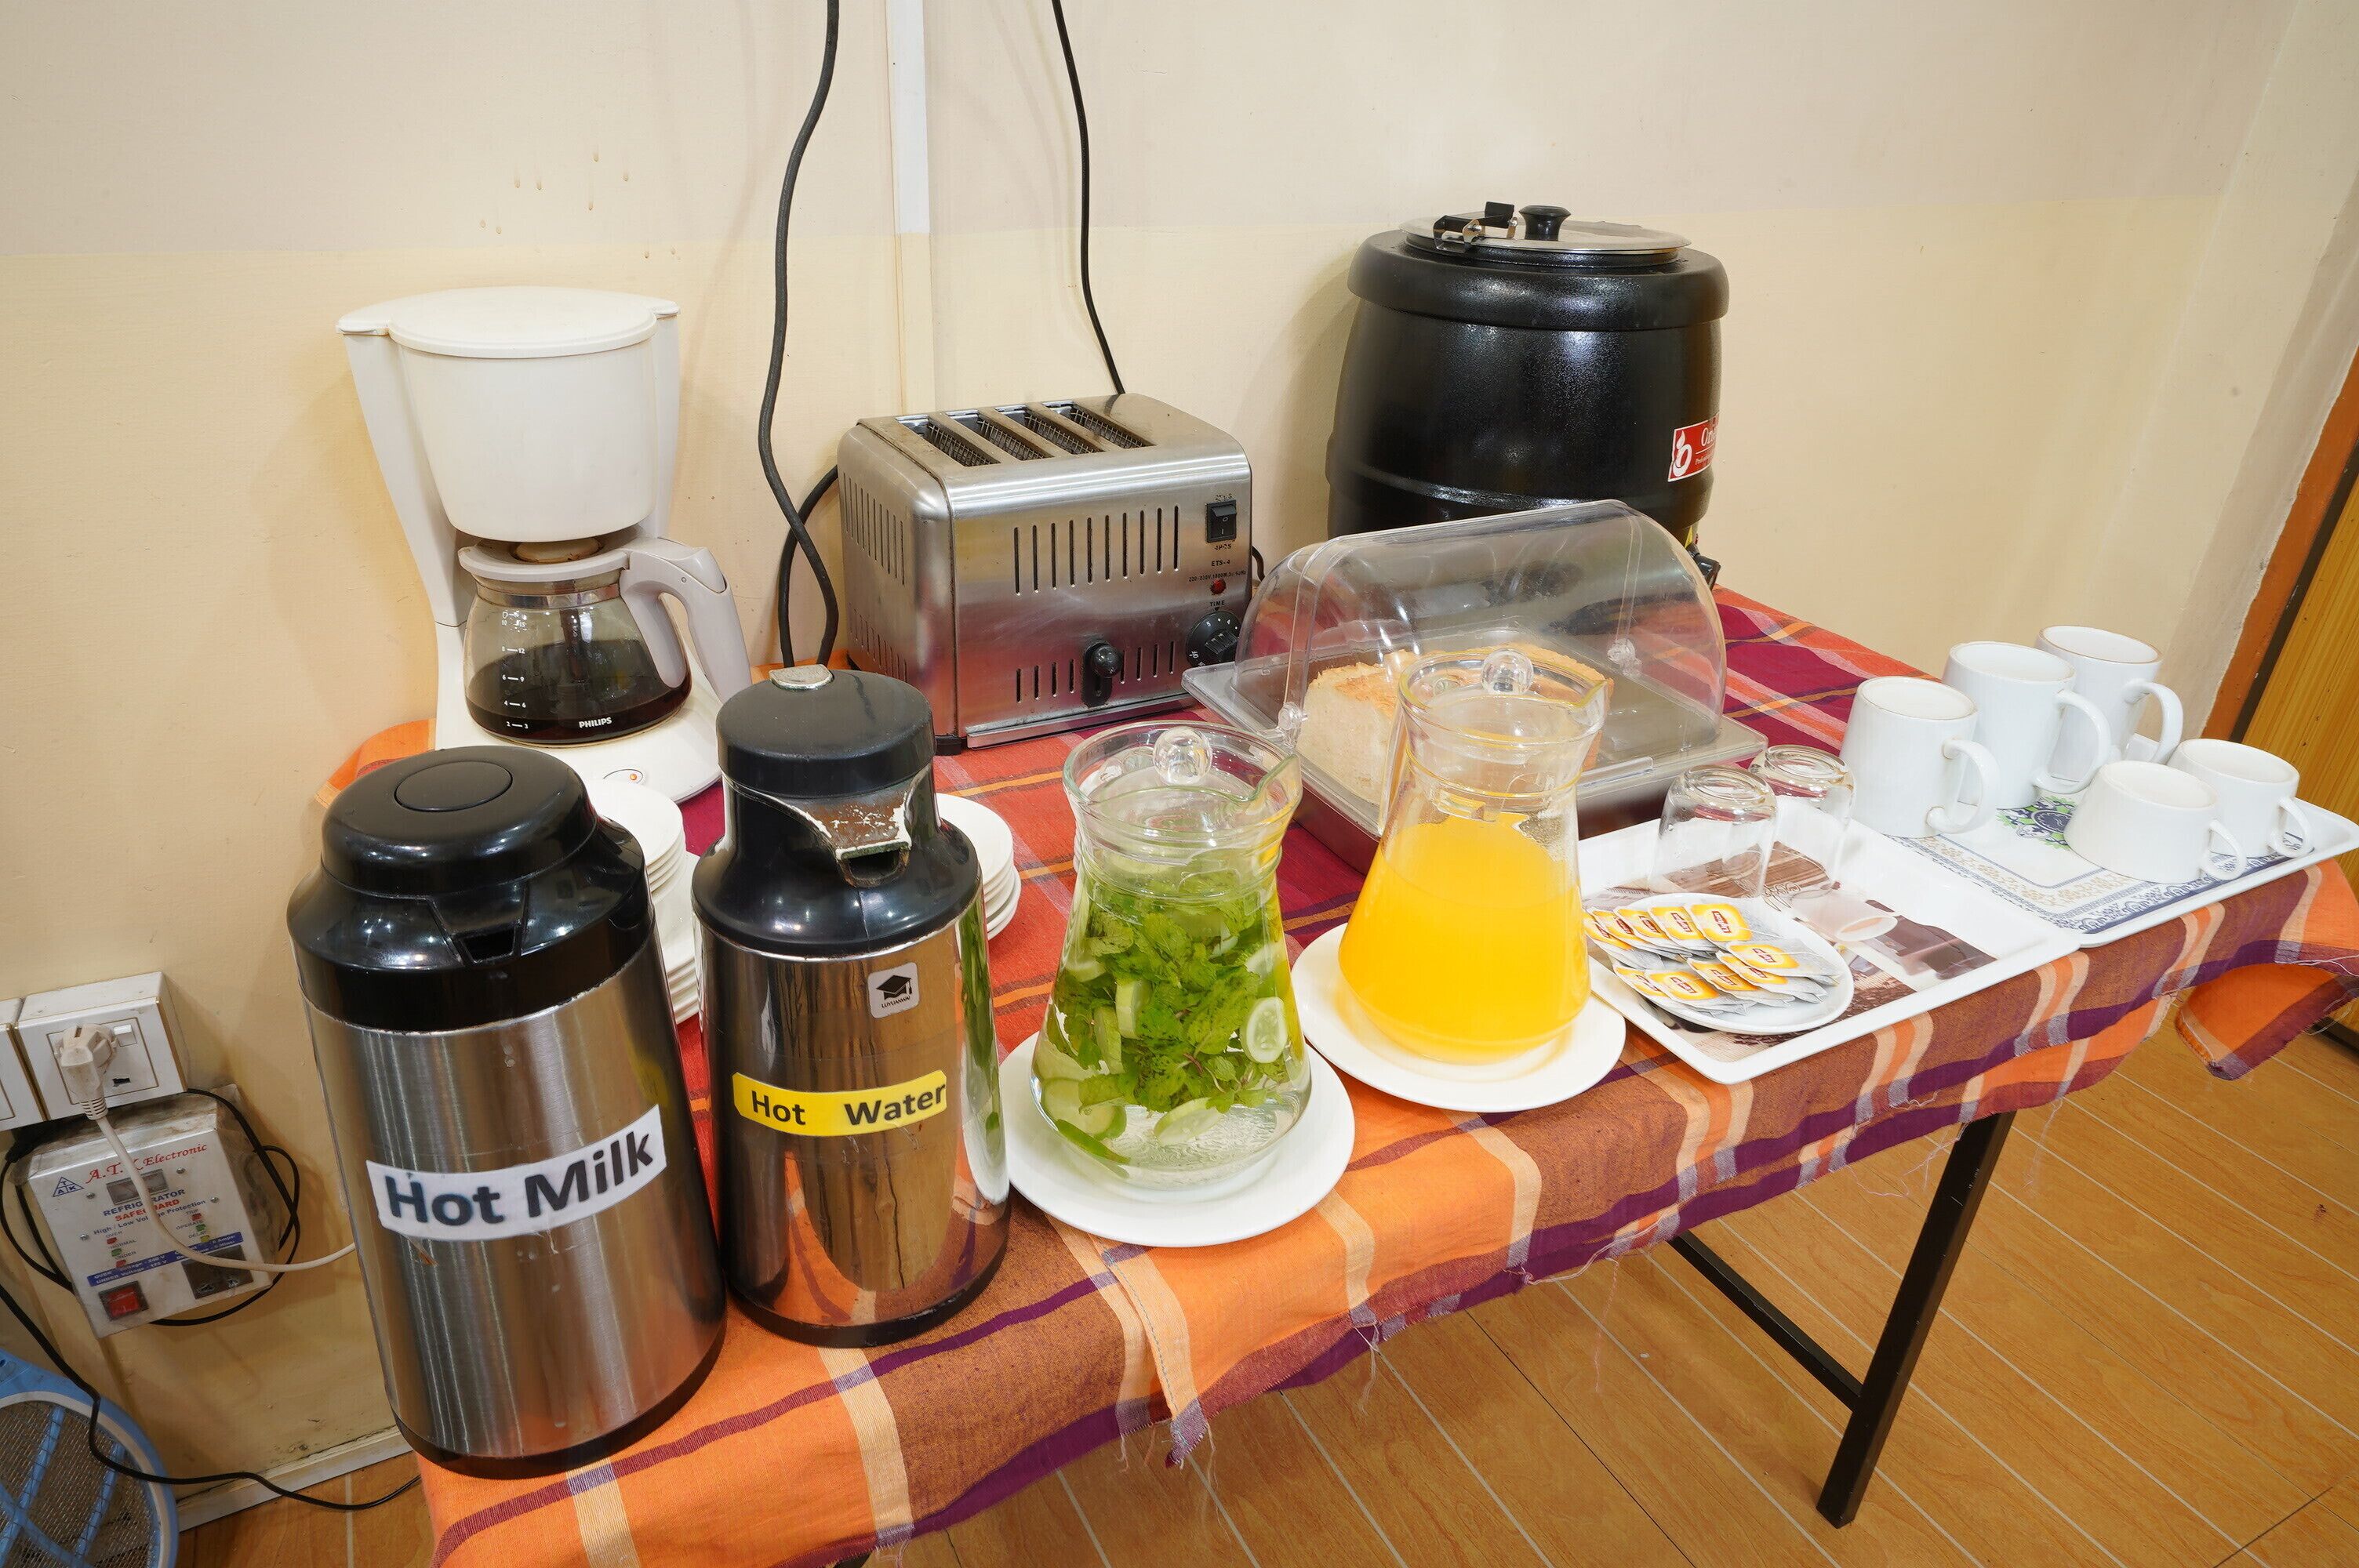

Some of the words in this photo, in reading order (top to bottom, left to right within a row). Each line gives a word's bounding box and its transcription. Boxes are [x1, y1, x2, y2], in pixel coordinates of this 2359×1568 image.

[578, 717, 612, 729] PHILIPS
[751, 1089, 806, 1126] Hot
[844, 1083, 946, 1127] Water
[143, 1143, 208, 1167] Electronic
[384, 1174, 506, 1226] Hot
[524, 1131, 654, 1218] Milk
[103, 1189, 186, 1217] REFRIGRATOR
[114, 1199, 180, 1221] SAFEARD
[93, 1226, 113, 1236] High
[118, 1220, 135, 1229] Low
[166, 1199, 206, 1214] Protection
